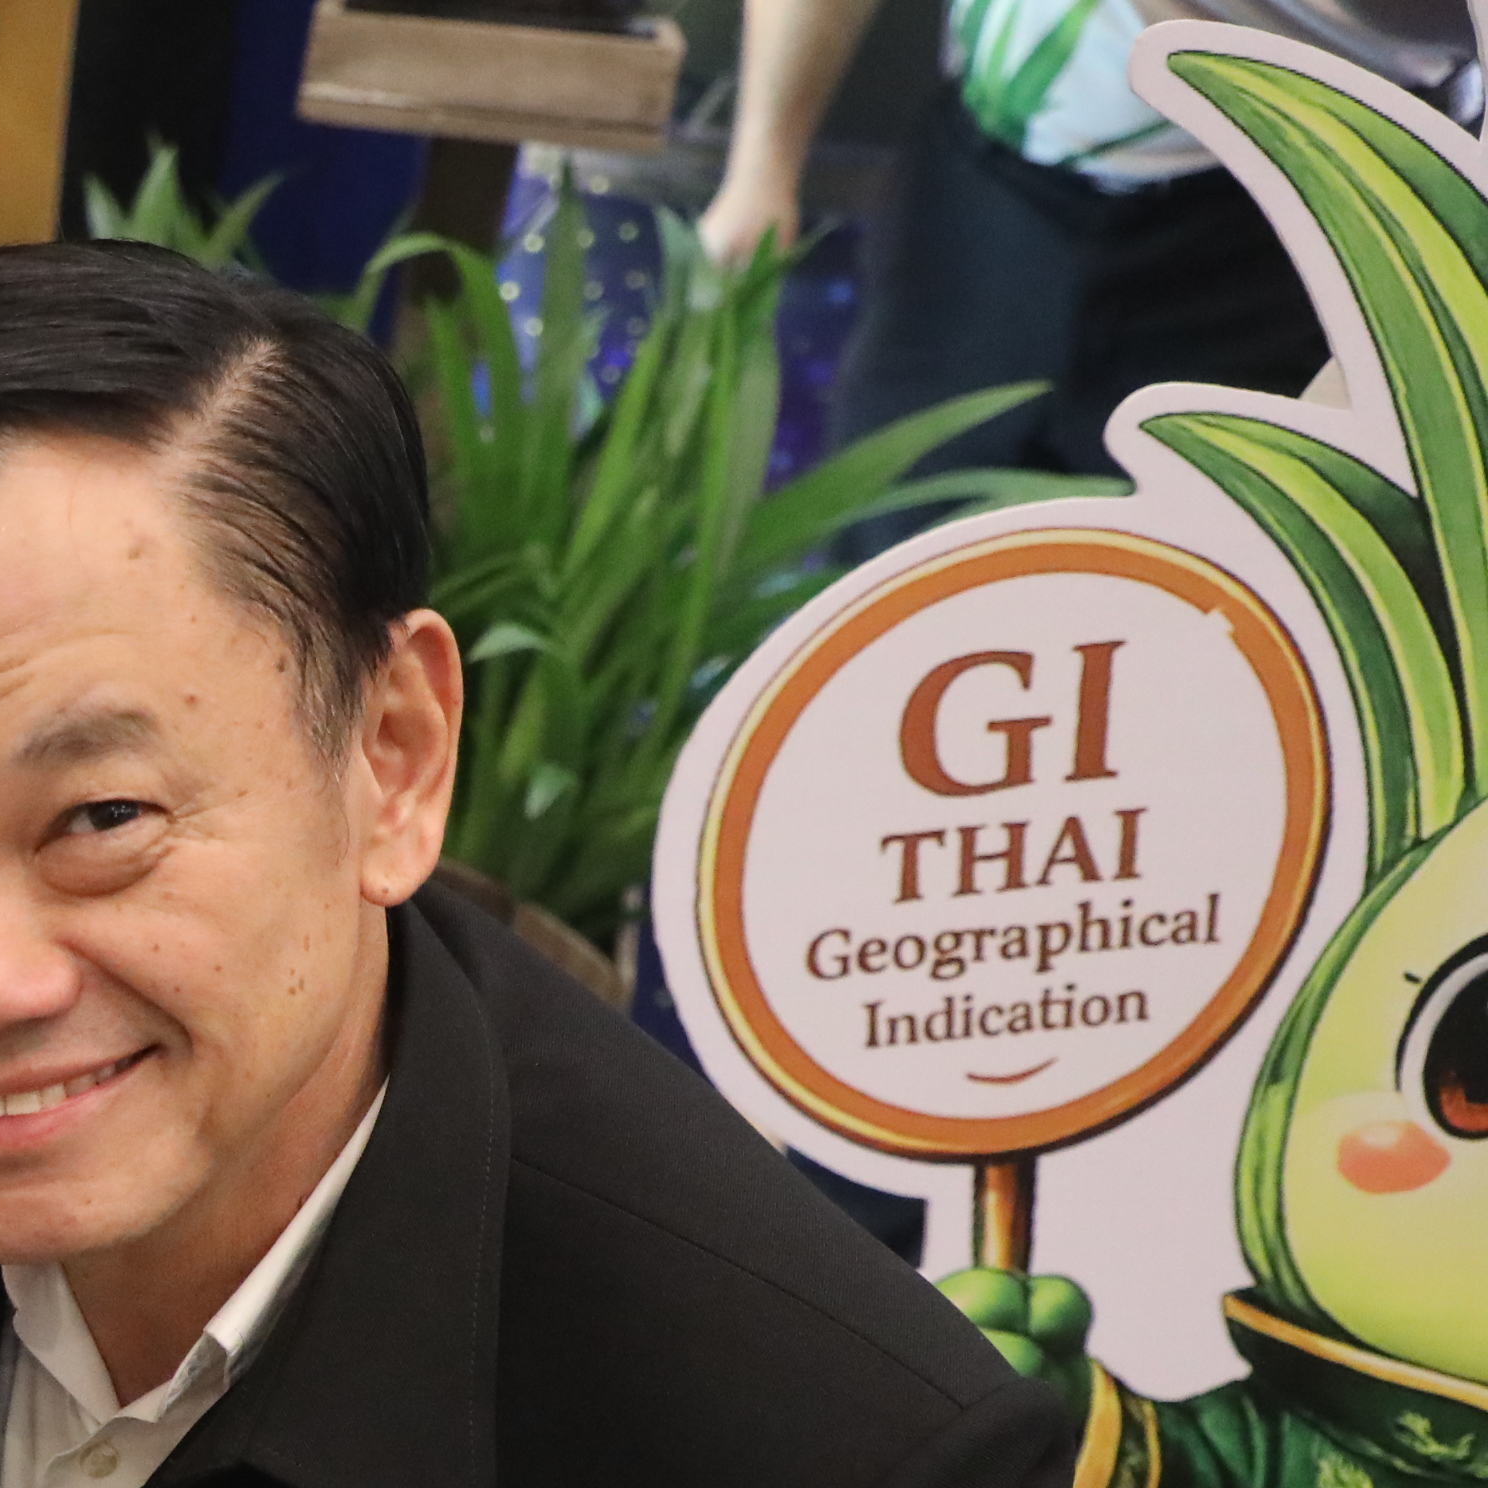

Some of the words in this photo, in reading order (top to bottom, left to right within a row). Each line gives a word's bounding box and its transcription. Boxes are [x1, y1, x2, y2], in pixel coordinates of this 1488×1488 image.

[898, 639, 1127, 798] GI
[880, 806, 1148, 904] THAI
[806, 893, 1222, 981] Geographical
[865, 984, 1150, 1049] Indication
